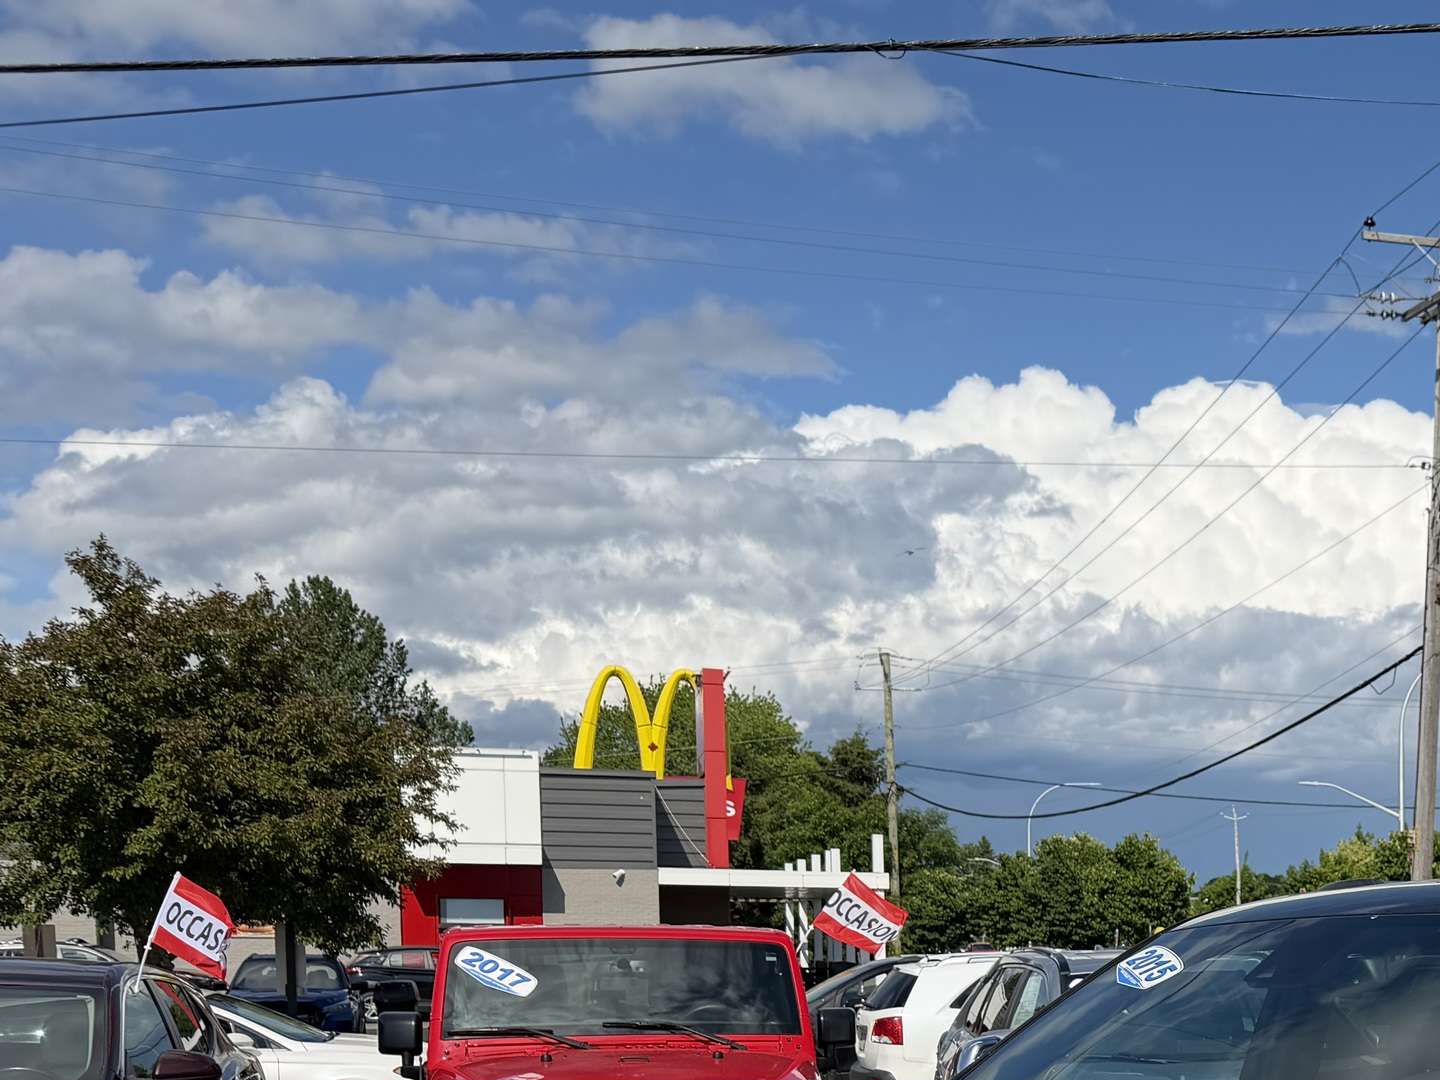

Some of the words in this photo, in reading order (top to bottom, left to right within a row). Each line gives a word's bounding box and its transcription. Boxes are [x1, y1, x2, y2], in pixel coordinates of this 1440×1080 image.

[165, 901, 223, 953] OCCAS
[461, 951, 532, 988] 2017
[1126, 949, 1178, 982] 2015
